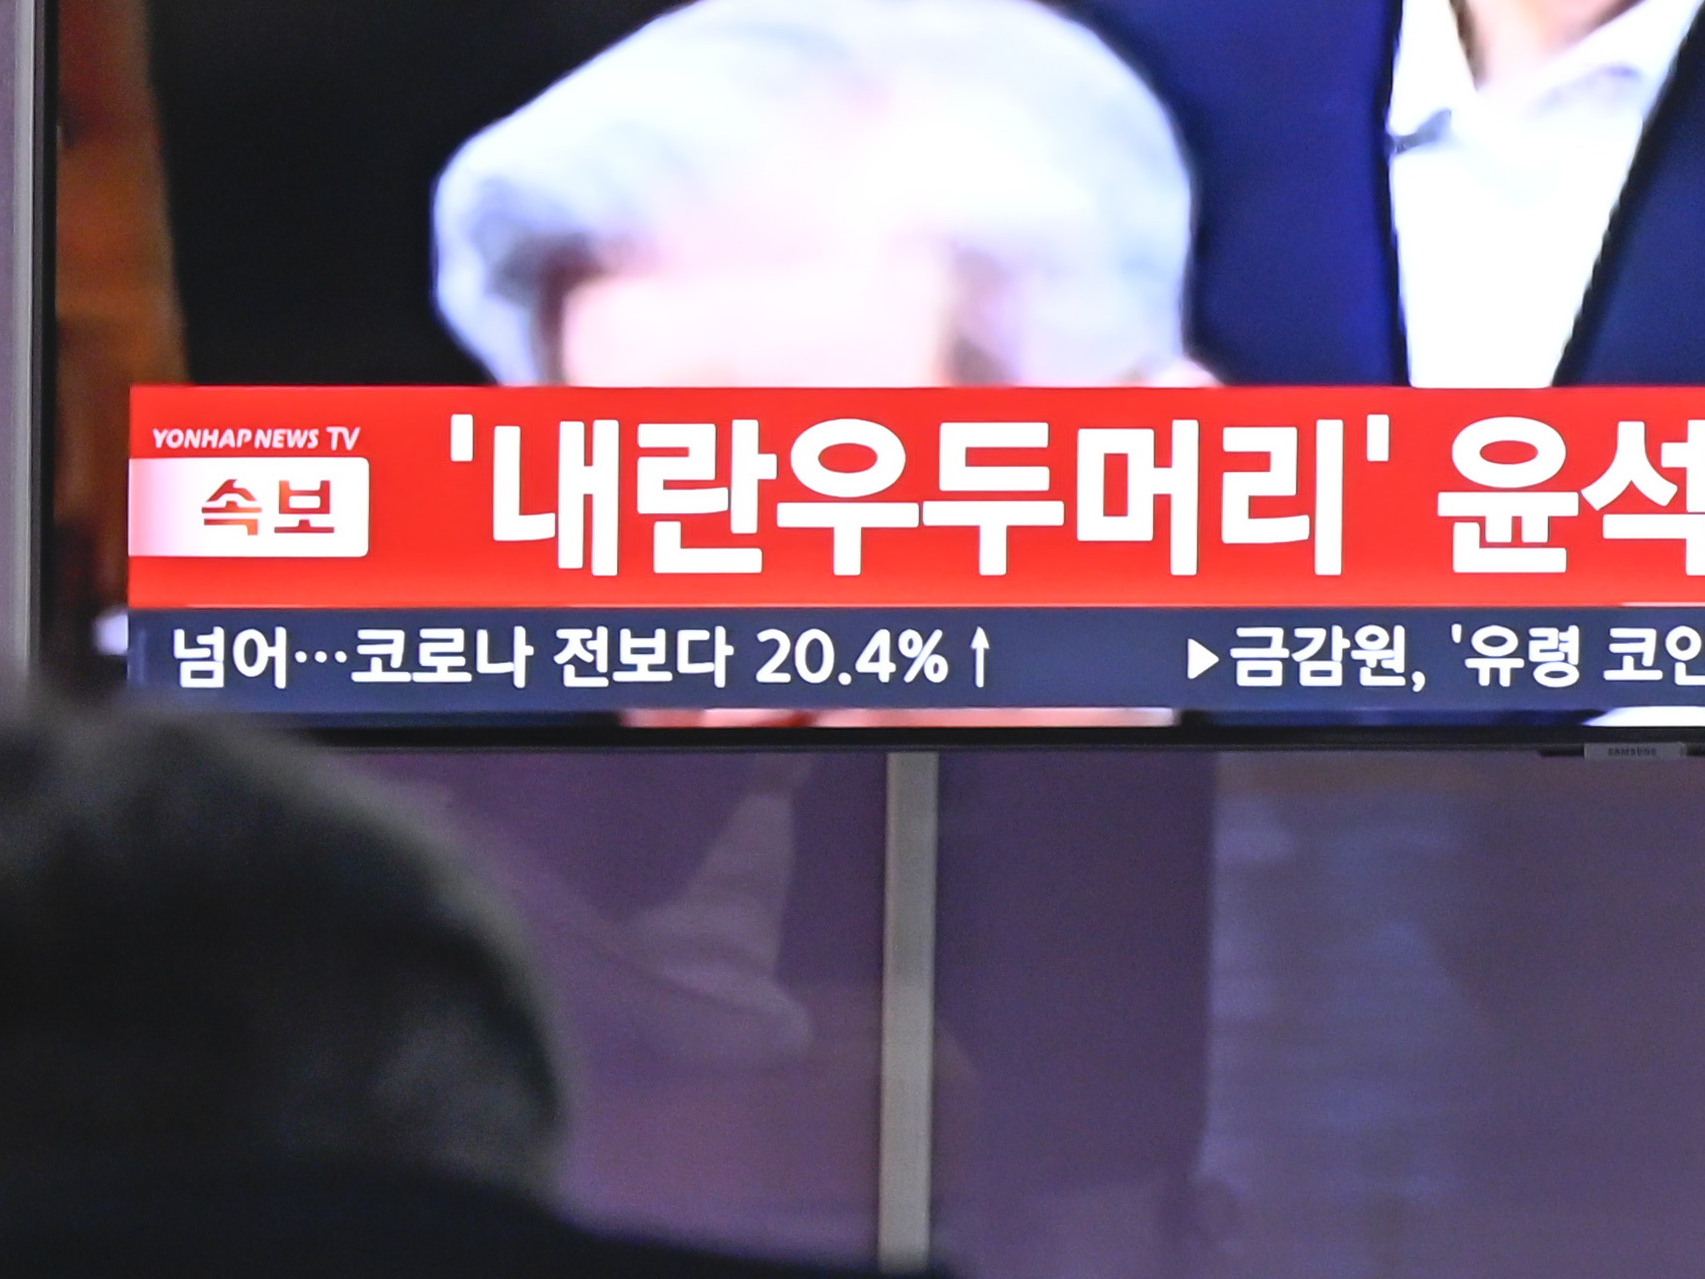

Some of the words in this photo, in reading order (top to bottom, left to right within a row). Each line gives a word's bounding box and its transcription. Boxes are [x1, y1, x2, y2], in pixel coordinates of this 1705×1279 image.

[152, 428, 252, 449] YONHAP
[254, 428, 320, 450] NEWS
[325, 426, 361, 451] TV
[201, 478, 335, 536] 속보
[449, 413, 1390, 577] '내란우두머리'
[552, 625, 735, 688] 전보다
[755, 626, 950, 687] 20.4%
[1229, 624, 1426, 693] 금감원,
[1450, 623, 1582, 688] '유령
